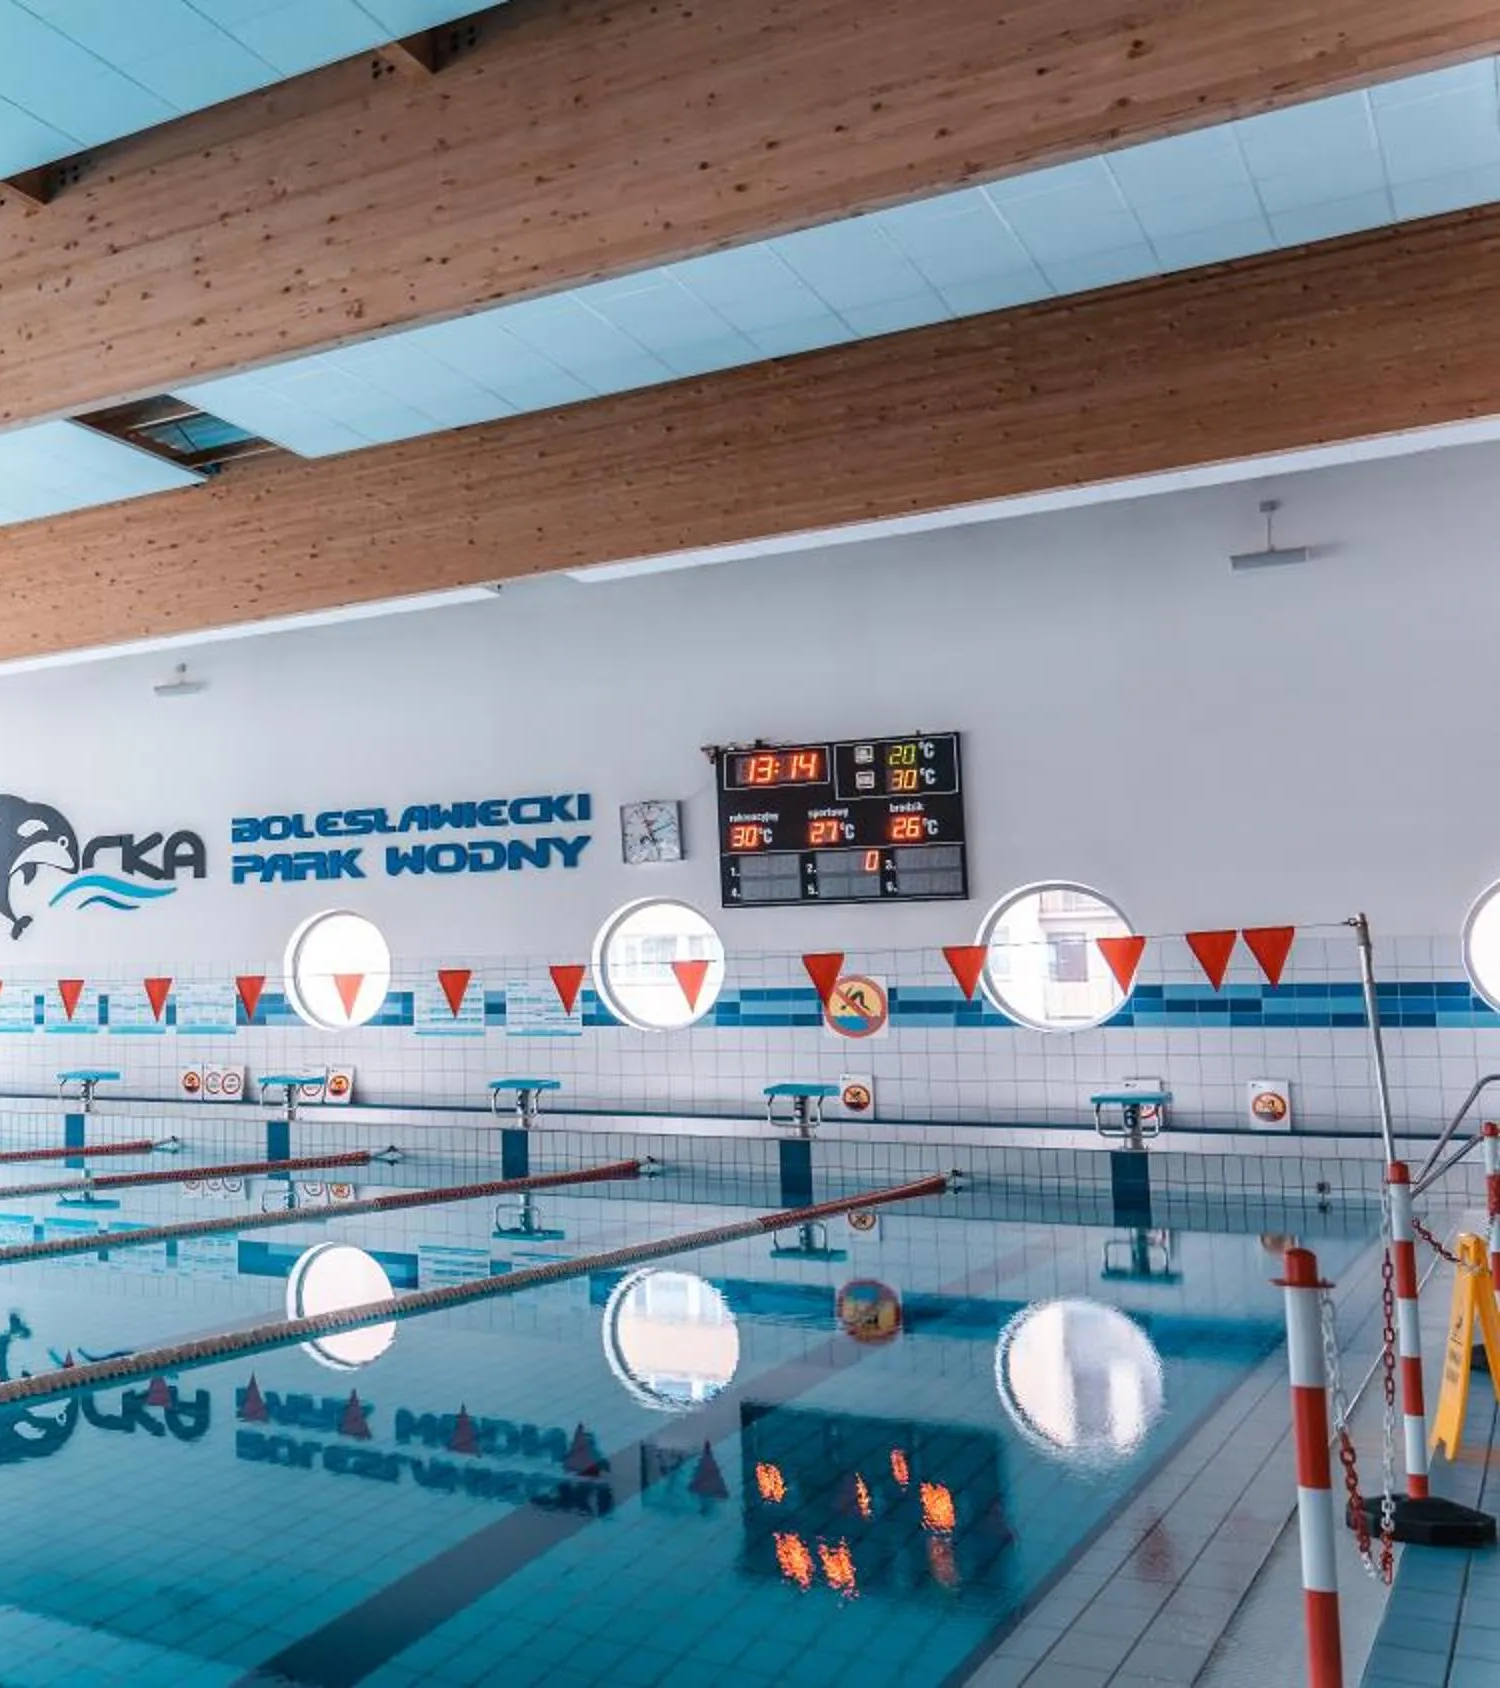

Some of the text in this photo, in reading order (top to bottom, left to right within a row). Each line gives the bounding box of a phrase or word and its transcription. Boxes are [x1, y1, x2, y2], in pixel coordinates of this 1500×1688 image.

[748, 753, 818, 784] 13:14
[231, 793, 592, 843] BOLESŁAWIECKI
[231, 835, 592, 885] PARK WODNY
[1124, 1109, 1137, 1128] 6
